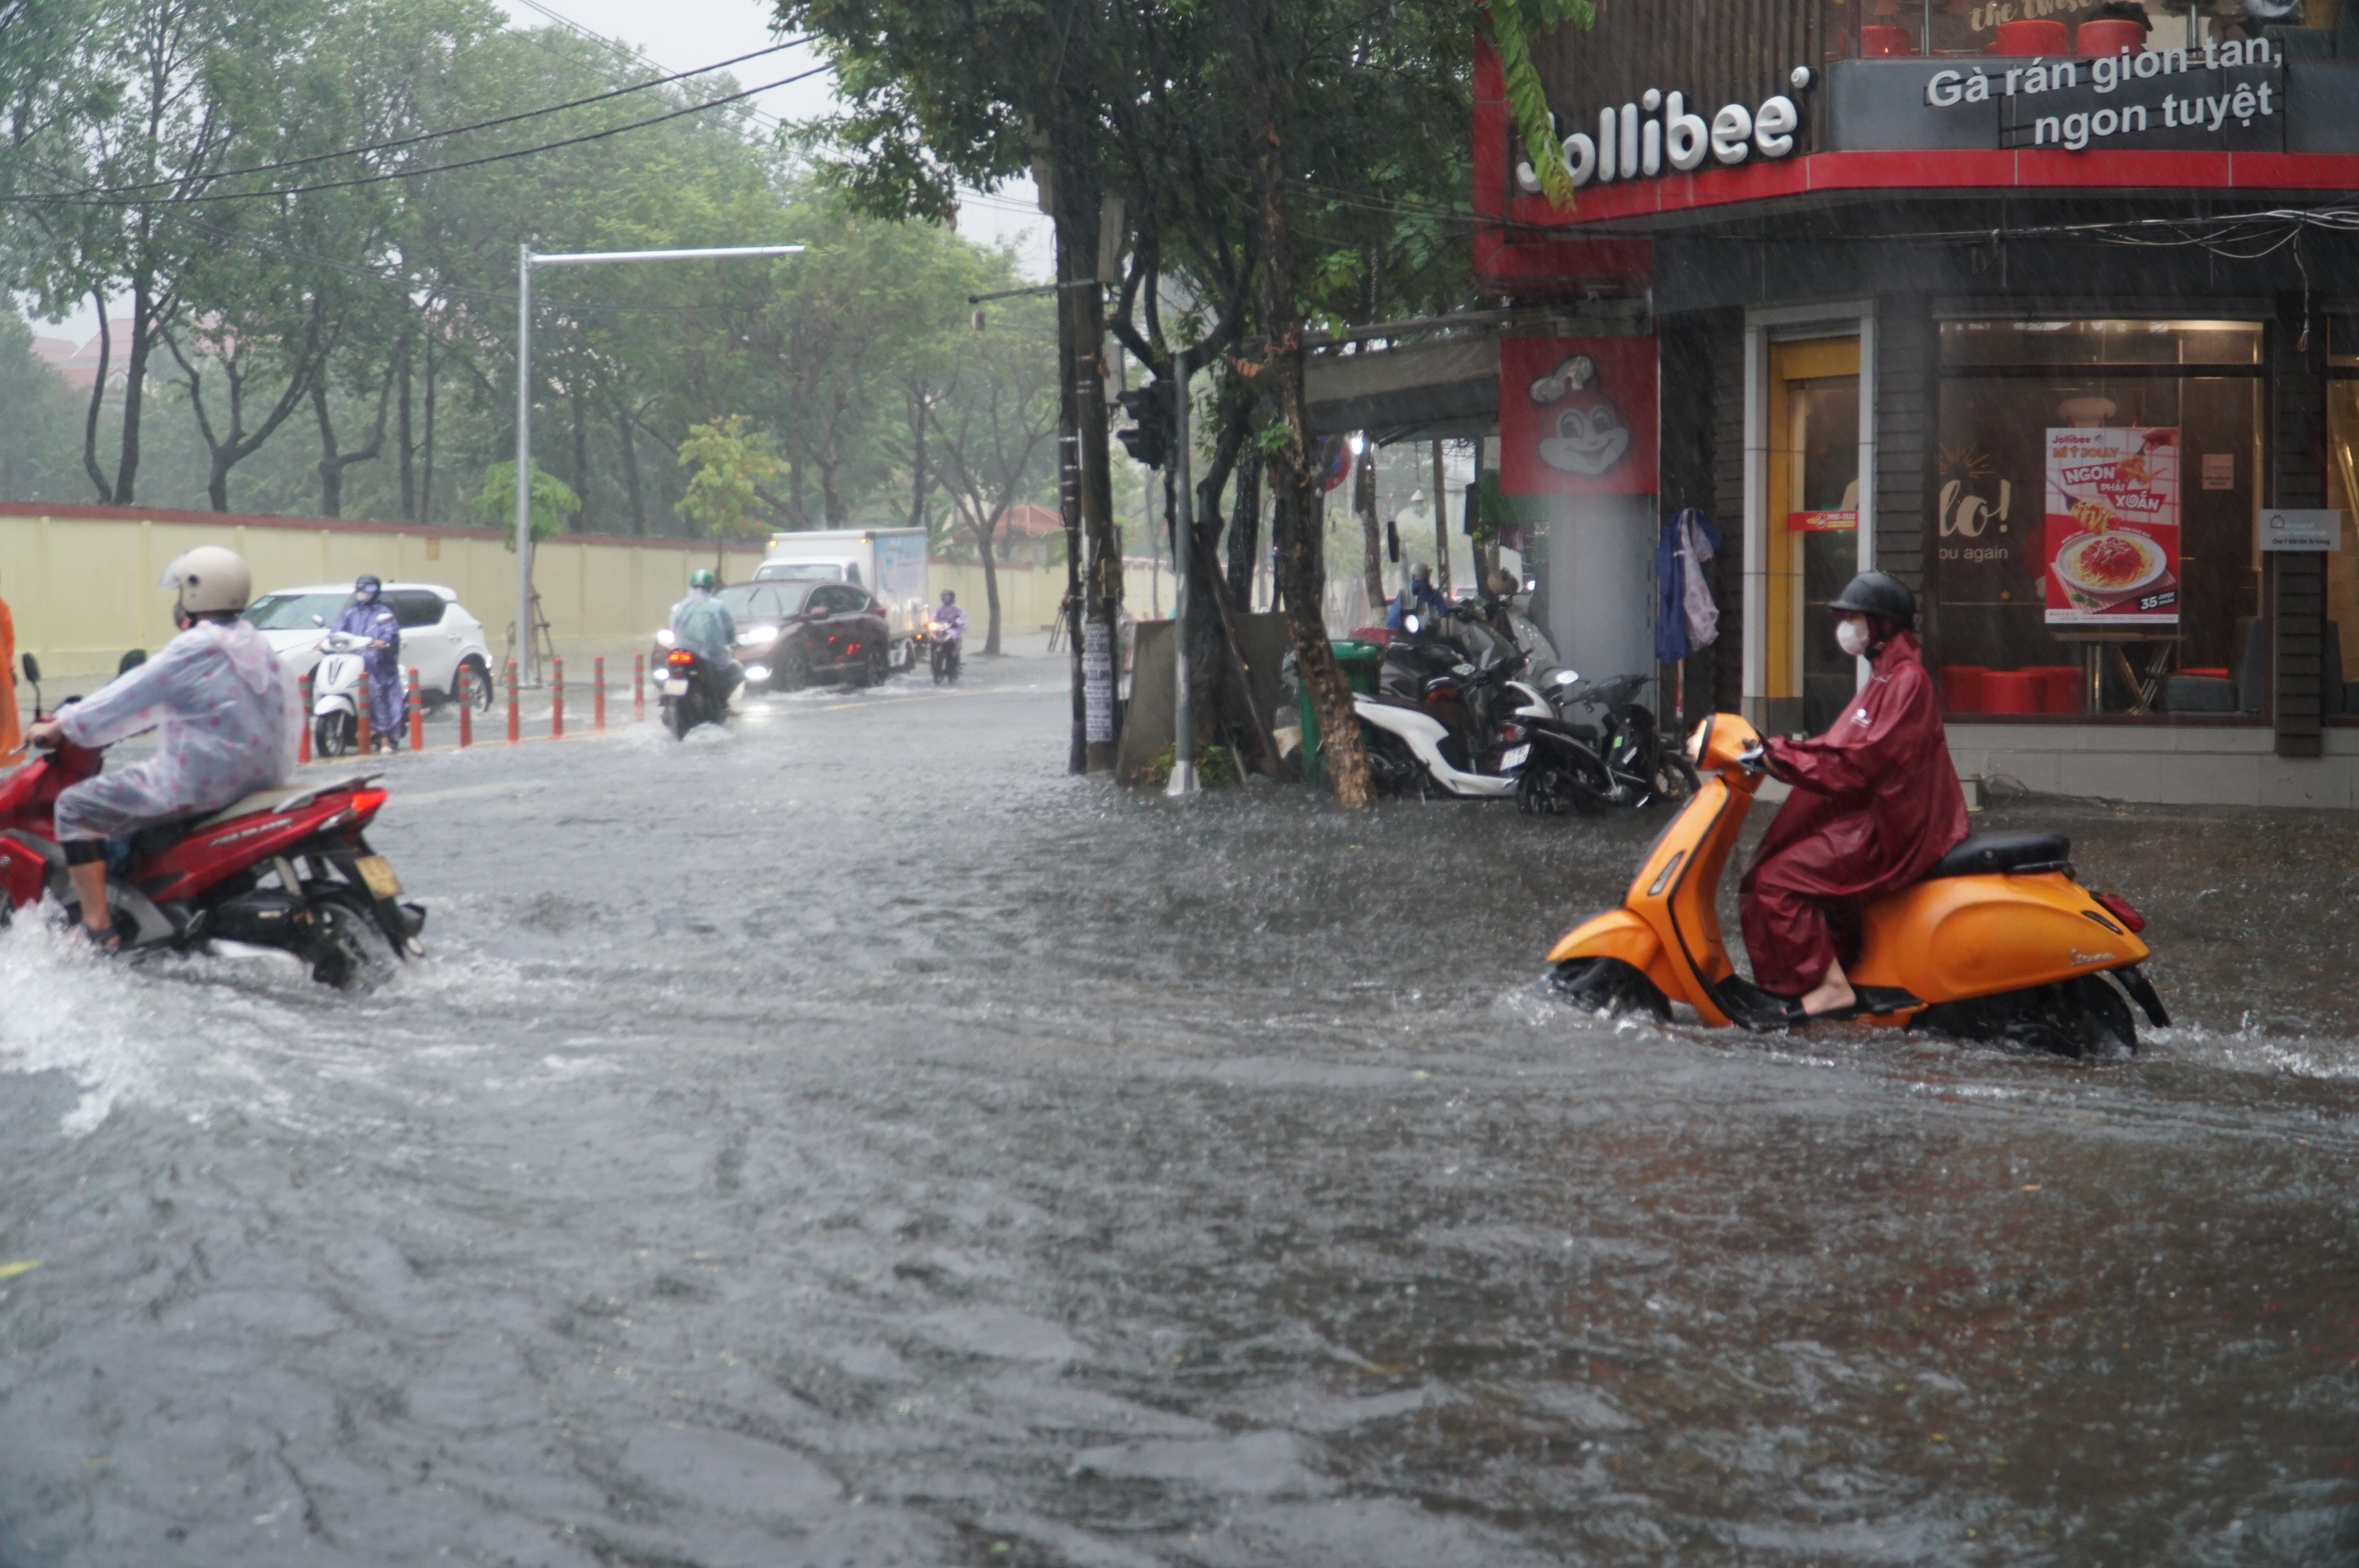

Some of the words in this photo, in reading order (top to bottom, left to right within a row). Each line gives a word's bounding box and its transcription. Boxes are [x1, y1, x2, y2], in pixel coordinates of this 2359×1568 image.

[1928, 66, 1990, 107] Gà
[2005, 57, 2077, 96] rán
[2092, 43, 2188, 93] giòn
[2203, 35, 2283, 70] tan,
[2034, 103, 2147, 151] ngon
[2162, 81, 2274, 132] tuyệt
[2052, 434, 2091, 444] Jollibee
[2066, 466, 2117, 484] NGON
[1964, 545, 2008, 563] again
[2140, 595, 2157, 610] 35
